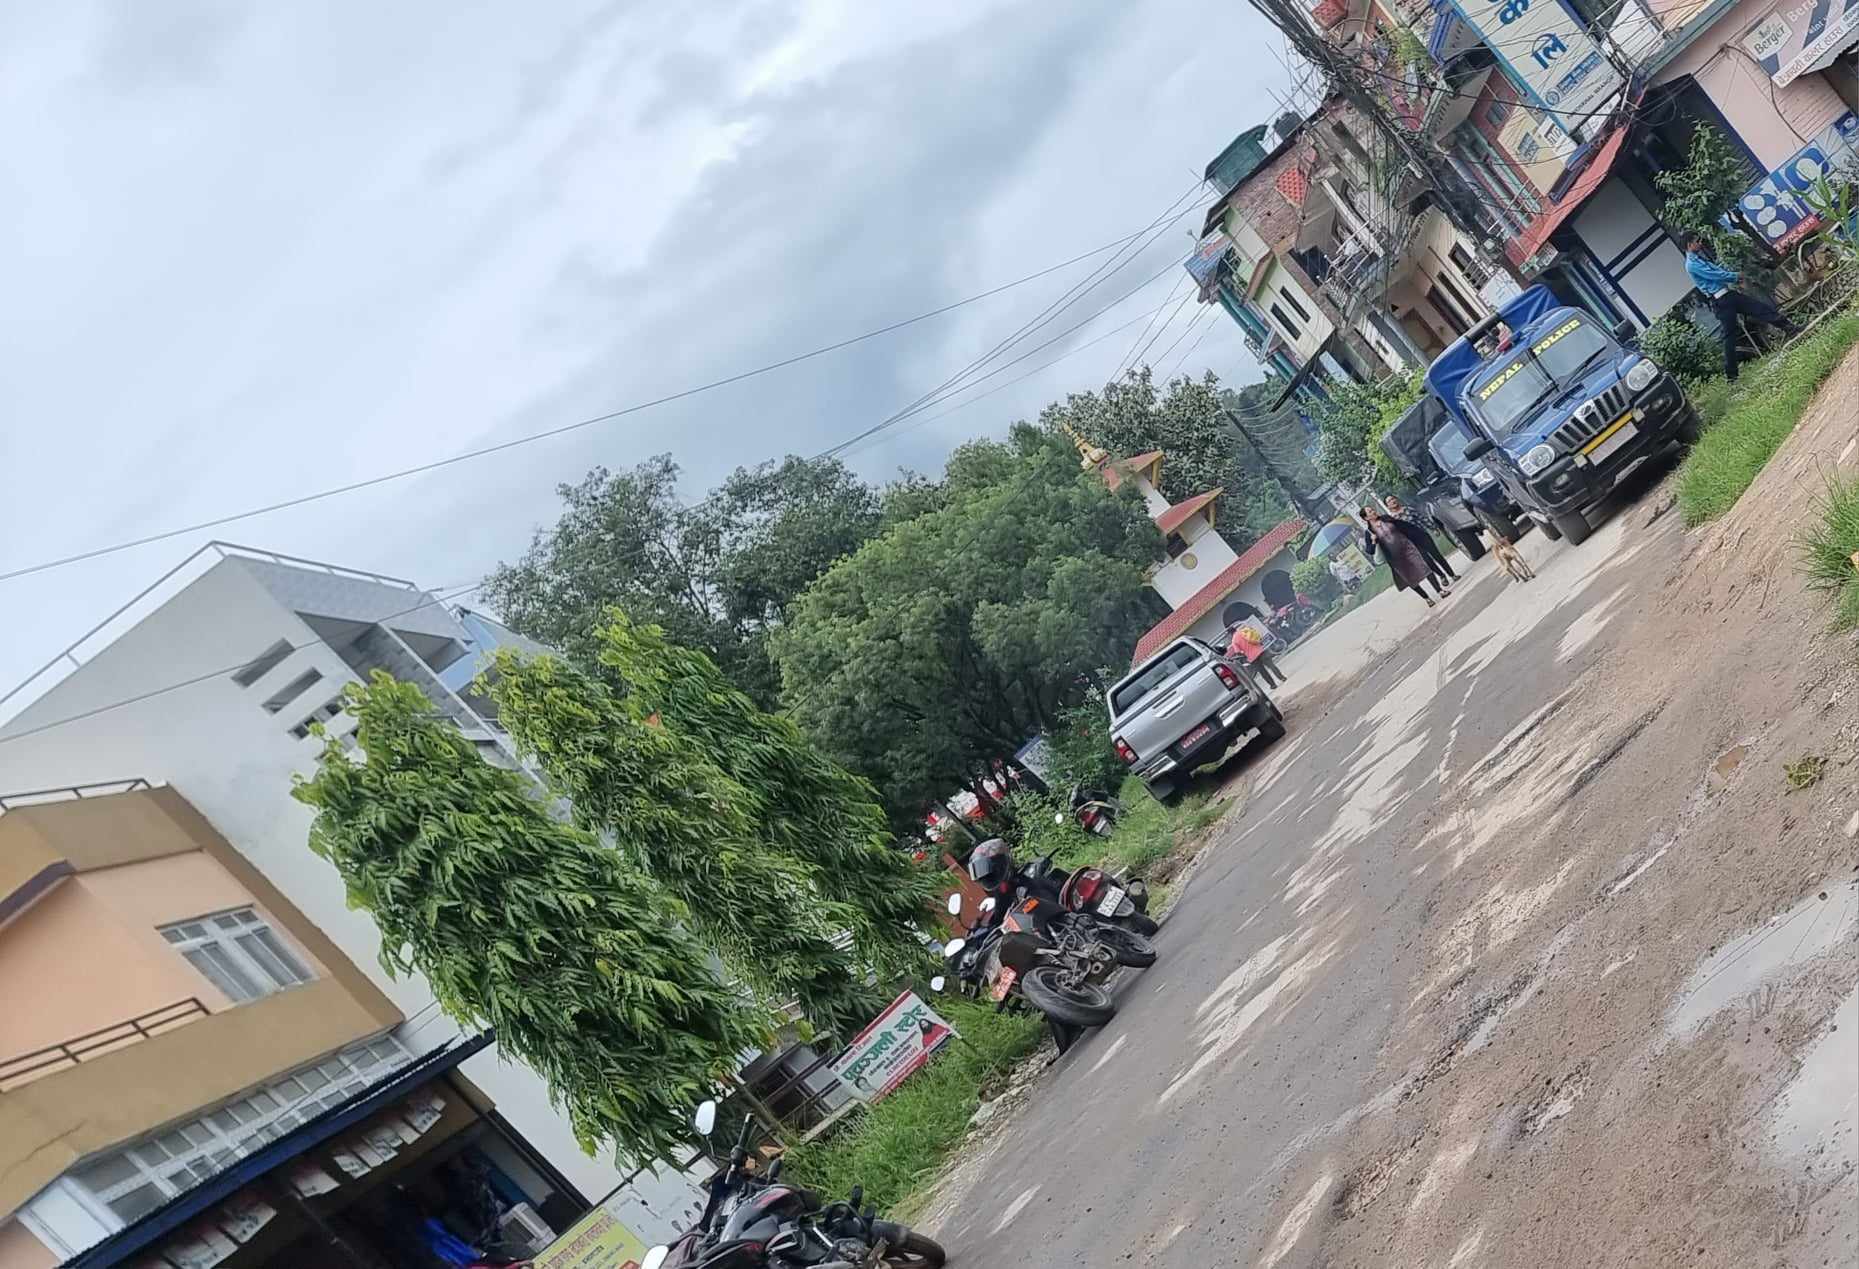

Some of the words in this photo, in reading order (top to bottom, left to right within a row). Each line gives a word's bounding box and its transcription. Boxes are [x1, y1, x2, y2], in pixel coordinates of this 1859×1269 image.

[1754, 25, 1785, 54] Berger
[1480, 361, 1524, 401] NEPAL
[1532, 319, 1580, 356] POLICE
[894, 1004, 927, 1033] स्टोर
